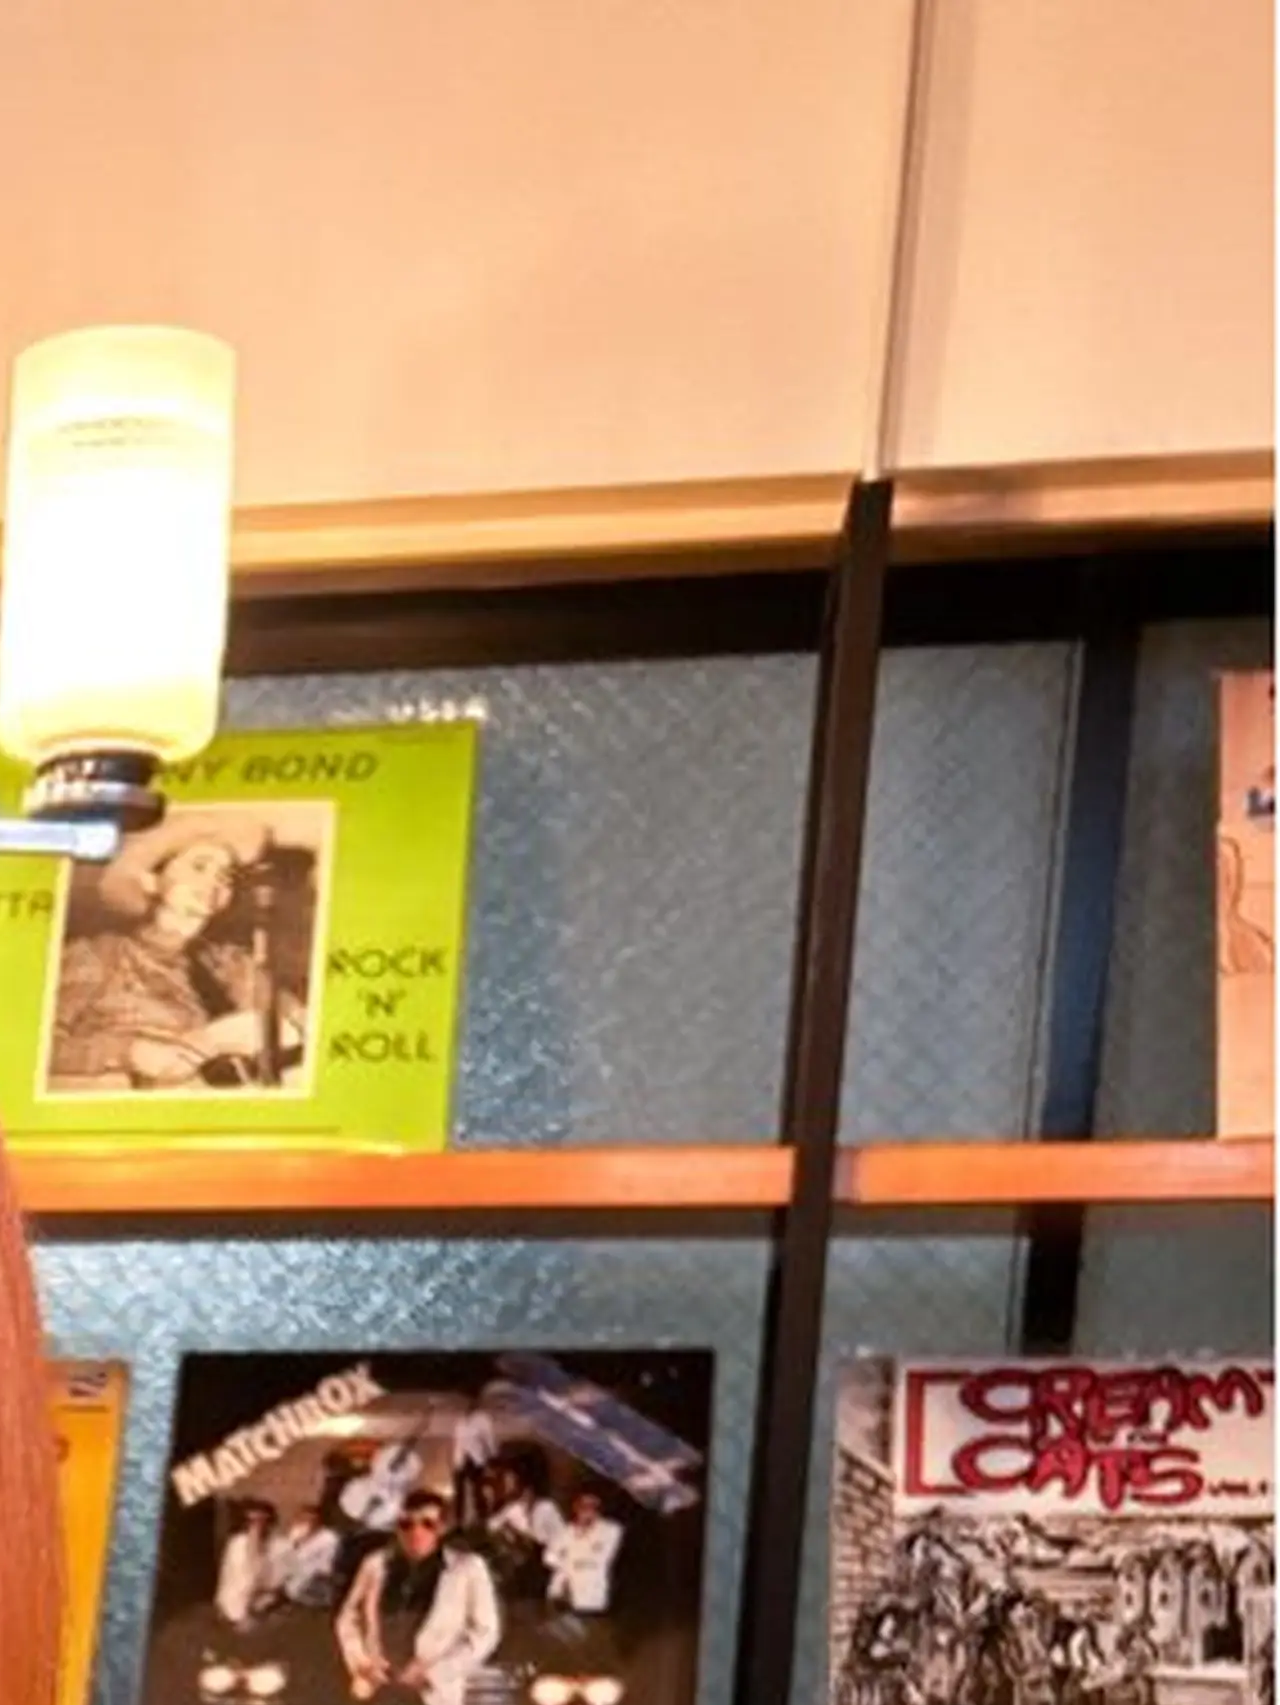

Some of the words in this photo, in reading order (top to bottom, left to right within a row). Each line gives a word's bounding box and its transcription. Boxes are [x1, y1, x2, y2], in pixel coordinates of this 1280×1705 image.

[242, 751, 380, 784] BOND
[327, 944, 450, 979] ROCK
[327, 1028, 439, 1064] ROLL
[170, 1360, 389, 1510] MATCHBOX
[950, 1434, 1205, 1511] CATS
